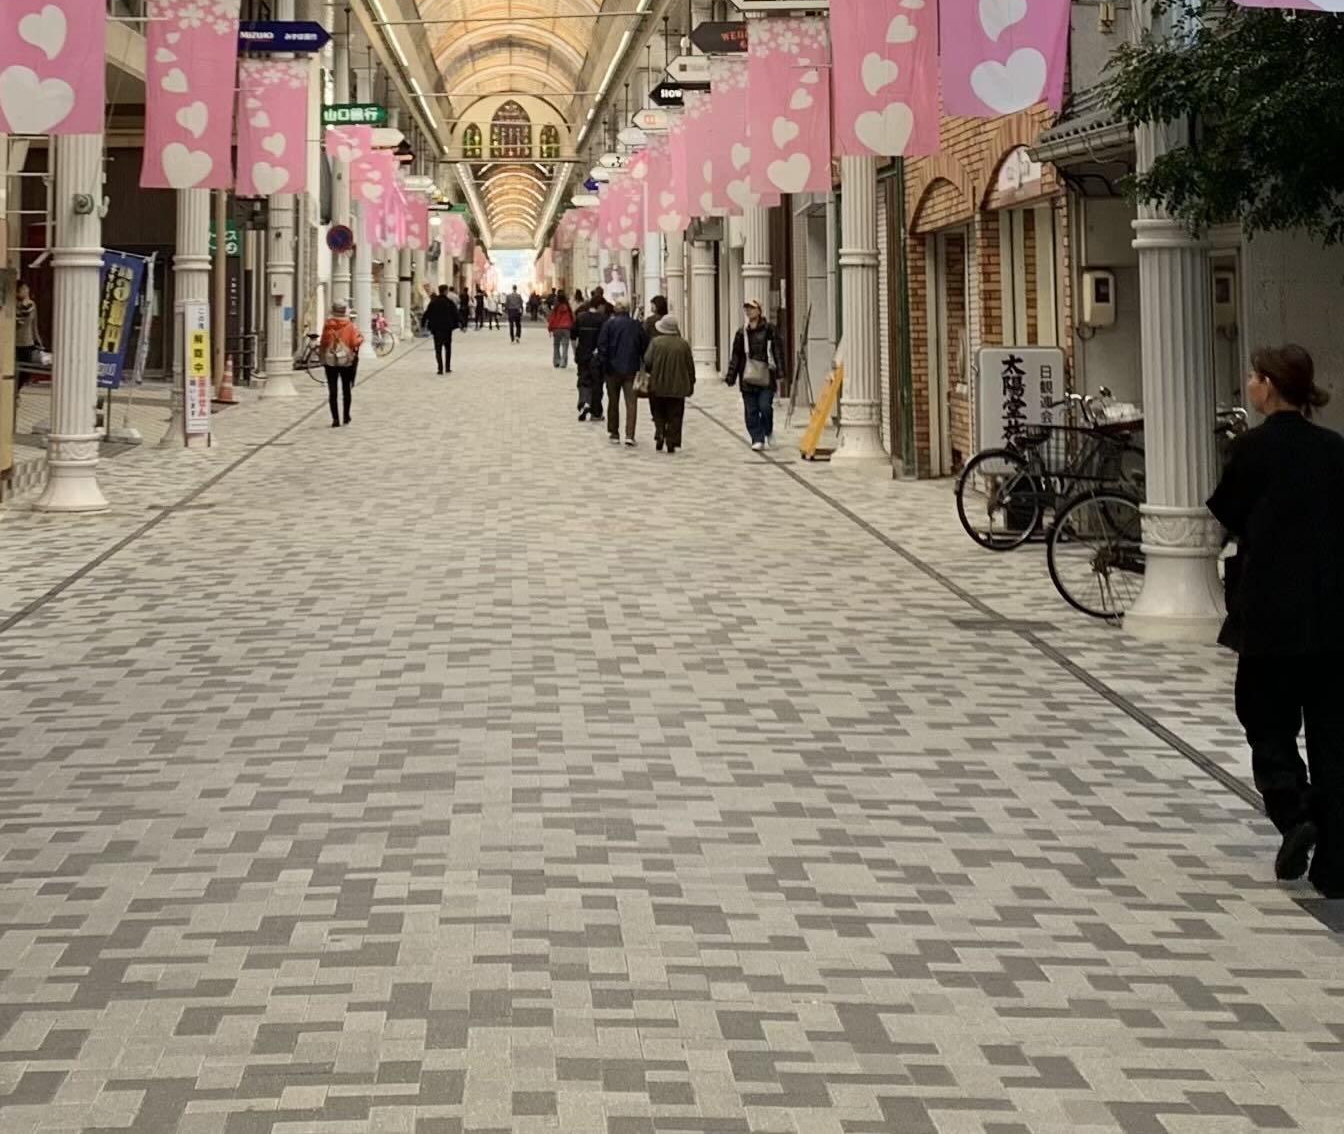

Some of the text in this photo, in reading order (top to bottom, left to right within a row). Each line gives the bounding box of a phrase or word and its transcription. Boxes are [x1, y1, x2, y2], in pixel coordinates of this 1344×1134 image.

[240, 31, 274, 40] MIZUHO
[324, 107, 378, 122] 山口銀行
